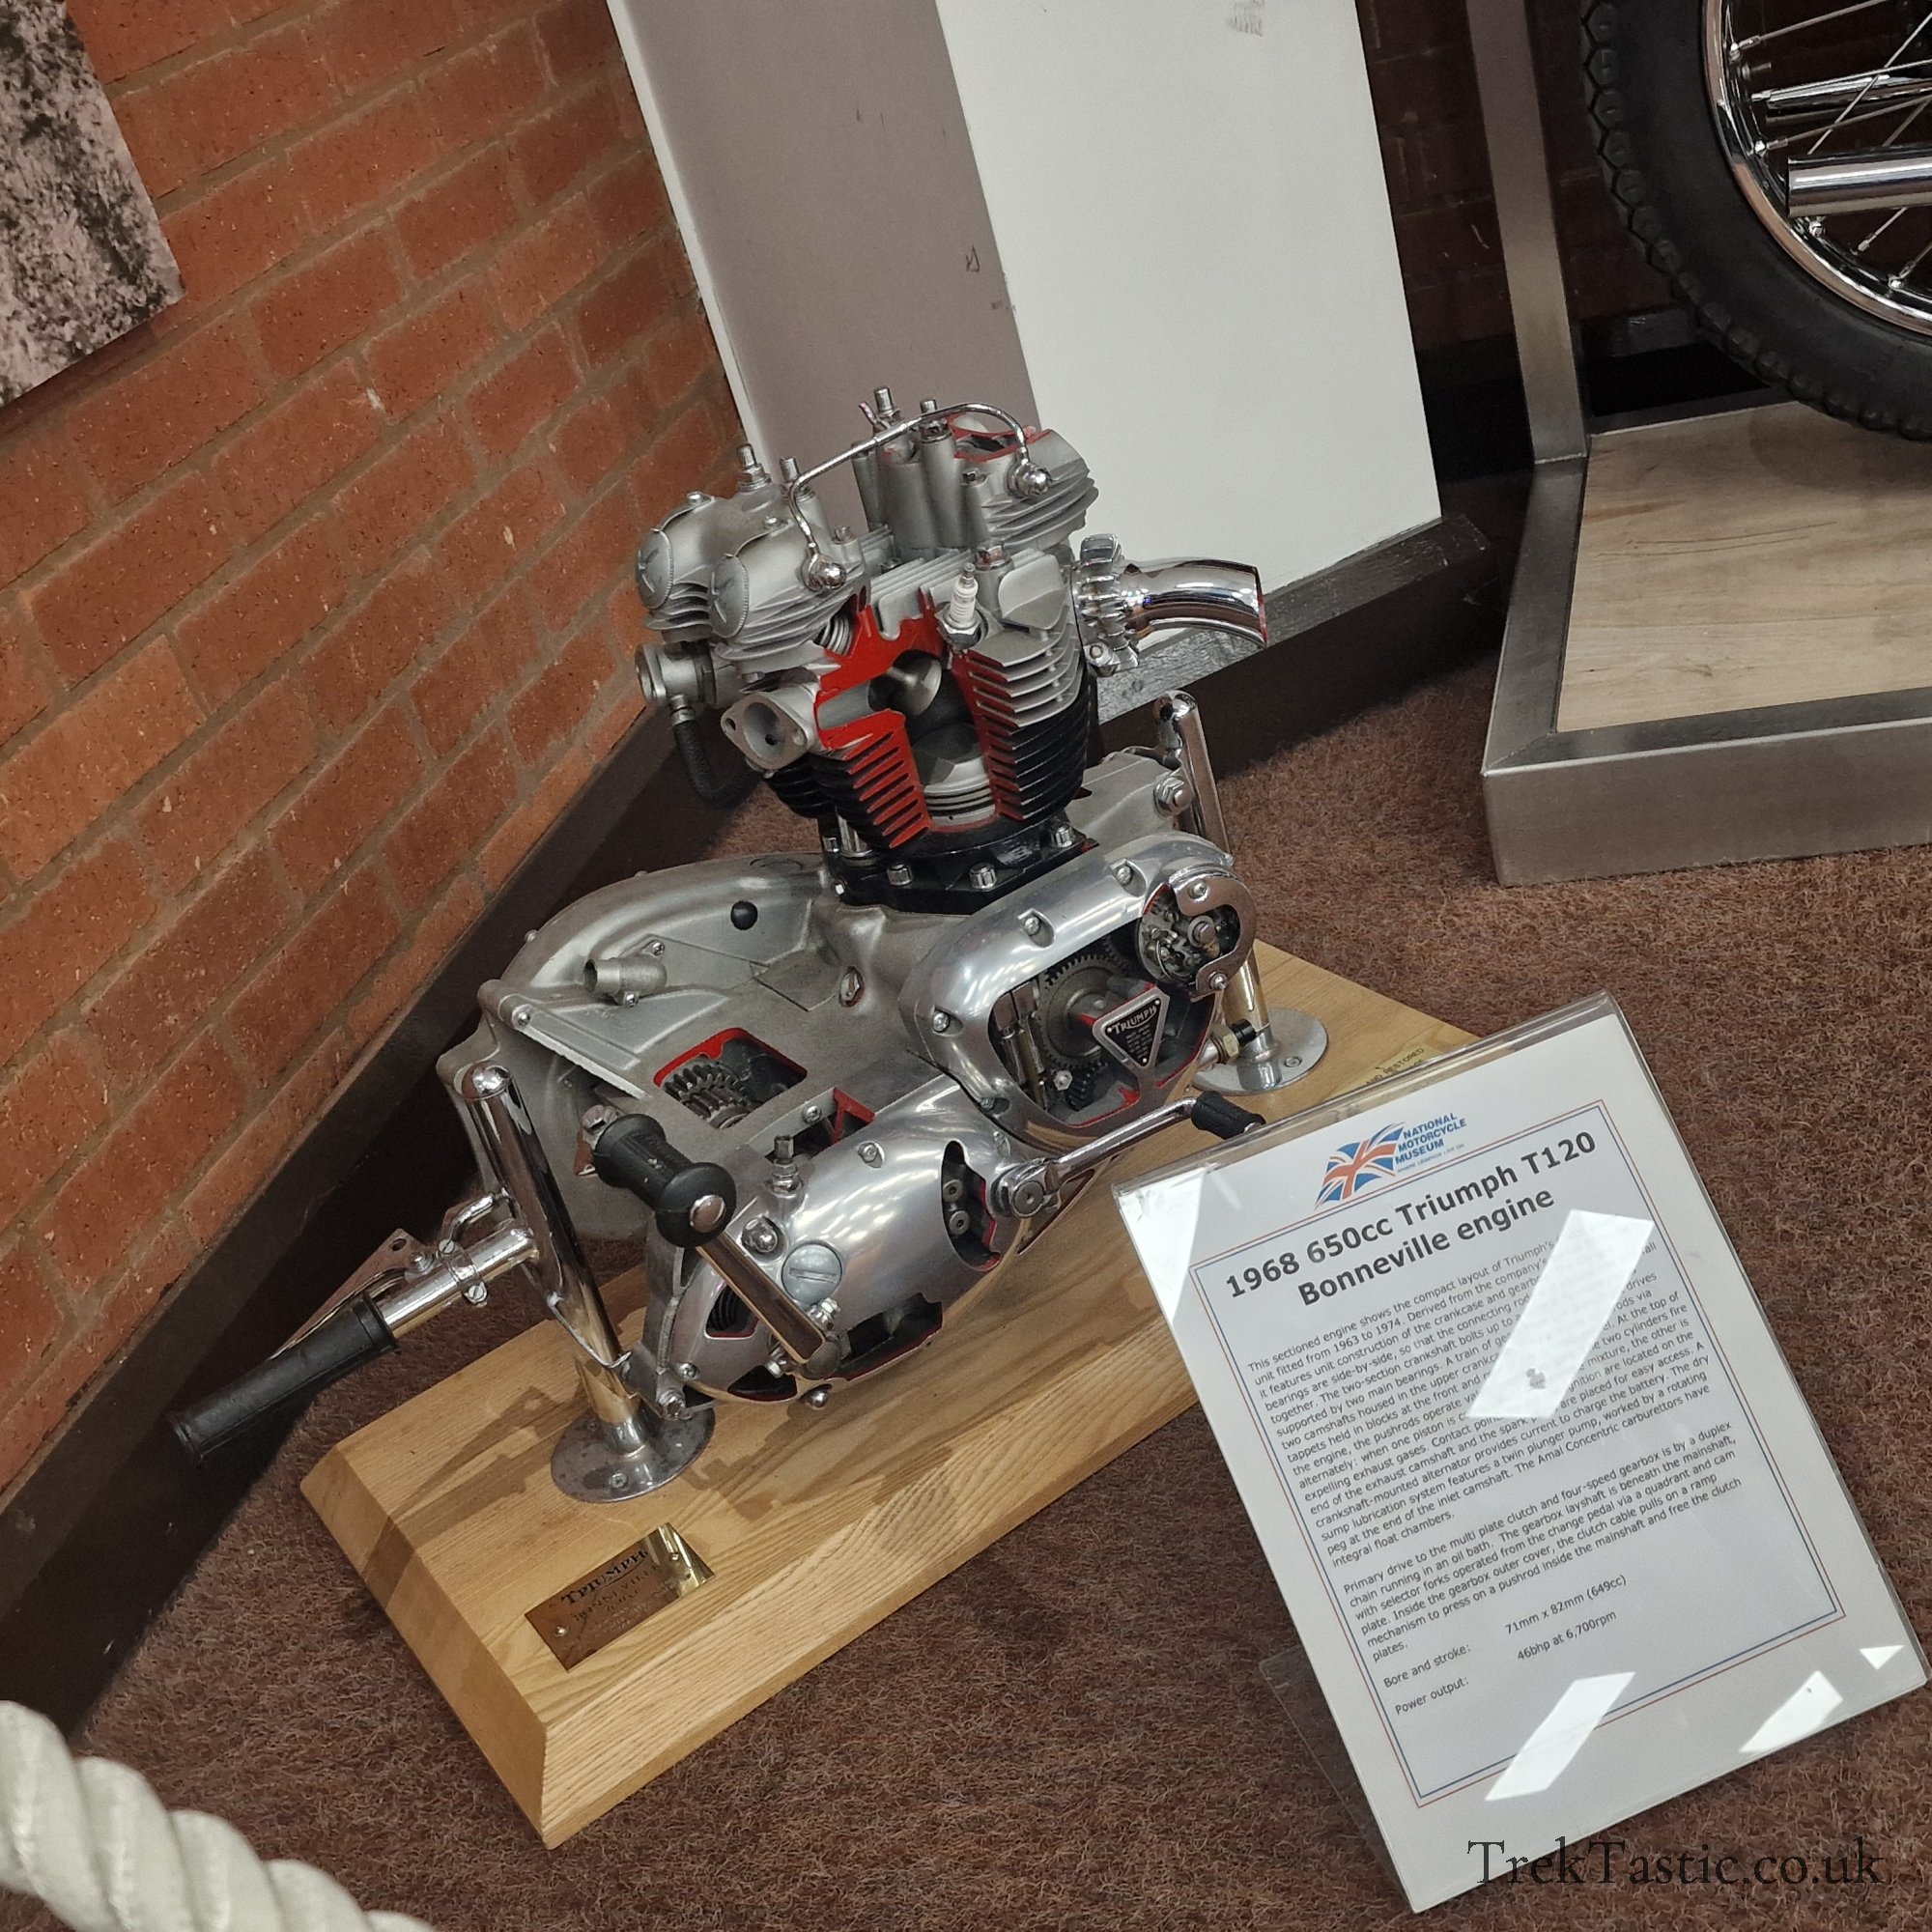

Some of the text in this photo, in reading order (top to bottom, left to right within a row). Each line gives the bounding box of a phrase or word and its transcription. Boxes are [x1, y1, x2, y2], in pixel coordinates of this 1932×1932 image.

[1111, 1005, 1157, 1034] TRIUMPH
[1395, 1138, 1444, 1164] MUSEUM
[1398, 1118, 1466, 1152] MOTORCYCLE
[1403, 1112, 1457, 1139] NATIONAL
[1226, 1131, 1595, 1297] 1968 650cc Triumph T120
[1297, 1232, 1450, 1305] Bonneville
[1457, 1190, 1554, 1240] engine
[1247, 1358, 1270, 1372] This
[1272, 1335, 1321, 1363] sectioned
[1322, 1322, 1357, 1341] engine
[1359, 1308, 1391, 1327] shows
[1413, 1280, 1456, 1304] compact
[1457, 1267, 1489, 1286] layout
[1502, 1241, 1554, 1266] Triumph's
[1254, 1370, 1275, 1385] unit
[1276, 1357, 1304, 1376] fitted
[1333, 1335, 1359, 1352] 1963
[1375, 1317, 1405, 1335] 1974.
[1406, 1298, 1446, 1321] Derived
[1494, 1258, 1547, 1285] company's
[1264, 1387, 1309, 1411] bearings
[1330, 1352, 1396, 1383] side-by-side,
[1456, 1303, 1511, 1330] connecting
[1268, 1299, 1483, 1394] features unit construction crankcase
[1276, 1272, 1656, 1437] supported main bearings. train drives
[1270, 1400, 1318, 1423] together.
[1341, 1364, 1401, 1394] two-section
[1403, 1339, 1457, 1368] crankshaft
[1458, 1329, 1484, 1345] bolts
[1287, 1384, 1458, 1463] tappets held blocks front
[1299, 1322, 1676, 1488] alternately: piston mixture, other
[1303, 1369, 1458, 1440] camshafts housed upper
[1304, 1476, 1351, 1501] expelling
[1352, 1457, 1394, 1480] exhaust
[1395, 1444, 1429, 1464] gases.
[1431, 1425, 1471, 1447] Contact
[1621, 1343, 1659, 1366] located
[1313, 1304, 1687, 1467] engine, pushrods operate cylinders fire
[1365, 1467, 1406, 1491] exhaust
[1408, 1446, 1456, 1472] camshaft
[1499, 1417, 1528, 1434] spark
[1579, 1379, 1612, 1402] placed
[1631, 1362, 1654, 1378] easy
[1657, 1347, 1693, 1367] access.
[1315, 1476, 1419, 1528] crankshaft-mounted
[1421, 1455, 1470, 1483] alternator
[1474, 1436, 1518, 1462] provides
[1520, 1418, 1558, 1440] current
[1572, 1398, 1607, 1418] charge
[1627, 1373, 1669, 1394] battery.
[1321, 1371, 1707, 1541] sump lubrication system features twin plunger pump, worked rotating
[1437, 1396, 1683, 1506] inlet camshaft. Amal Concentric carburettors
[1331, 1511, 1454, 1567] integral float chambers.
[1343, 1421, 1731, 1594] Primary drive multi plate clutch four-speed gearbox duplex
[1349, 1435, 1735, 1607] chain running bath. gearbox layshaft beneath mainshaft,
[1360, 1473, 1717, 1636] plate. Inside gearbox outer cover, clutch cable pulls ramp
[1367, 1478, 1741, 1647] mechanism press pushrod inside mainshaft free clutch
[1380, 1468, 1690, 1610] selector forks operated change pedal quadrant
[1372, 1641, 1407, 1663] plates.
[1504, 1574, 1626, 1634] 71mm x 82mm (649cc)
[1517, 1611, 1616, 1659] 46bhp at 6,700rpm
[1383, 1644, 1470, 1687] Bore stroke:
[1394, 1677, 1468, 1715] Power output:
